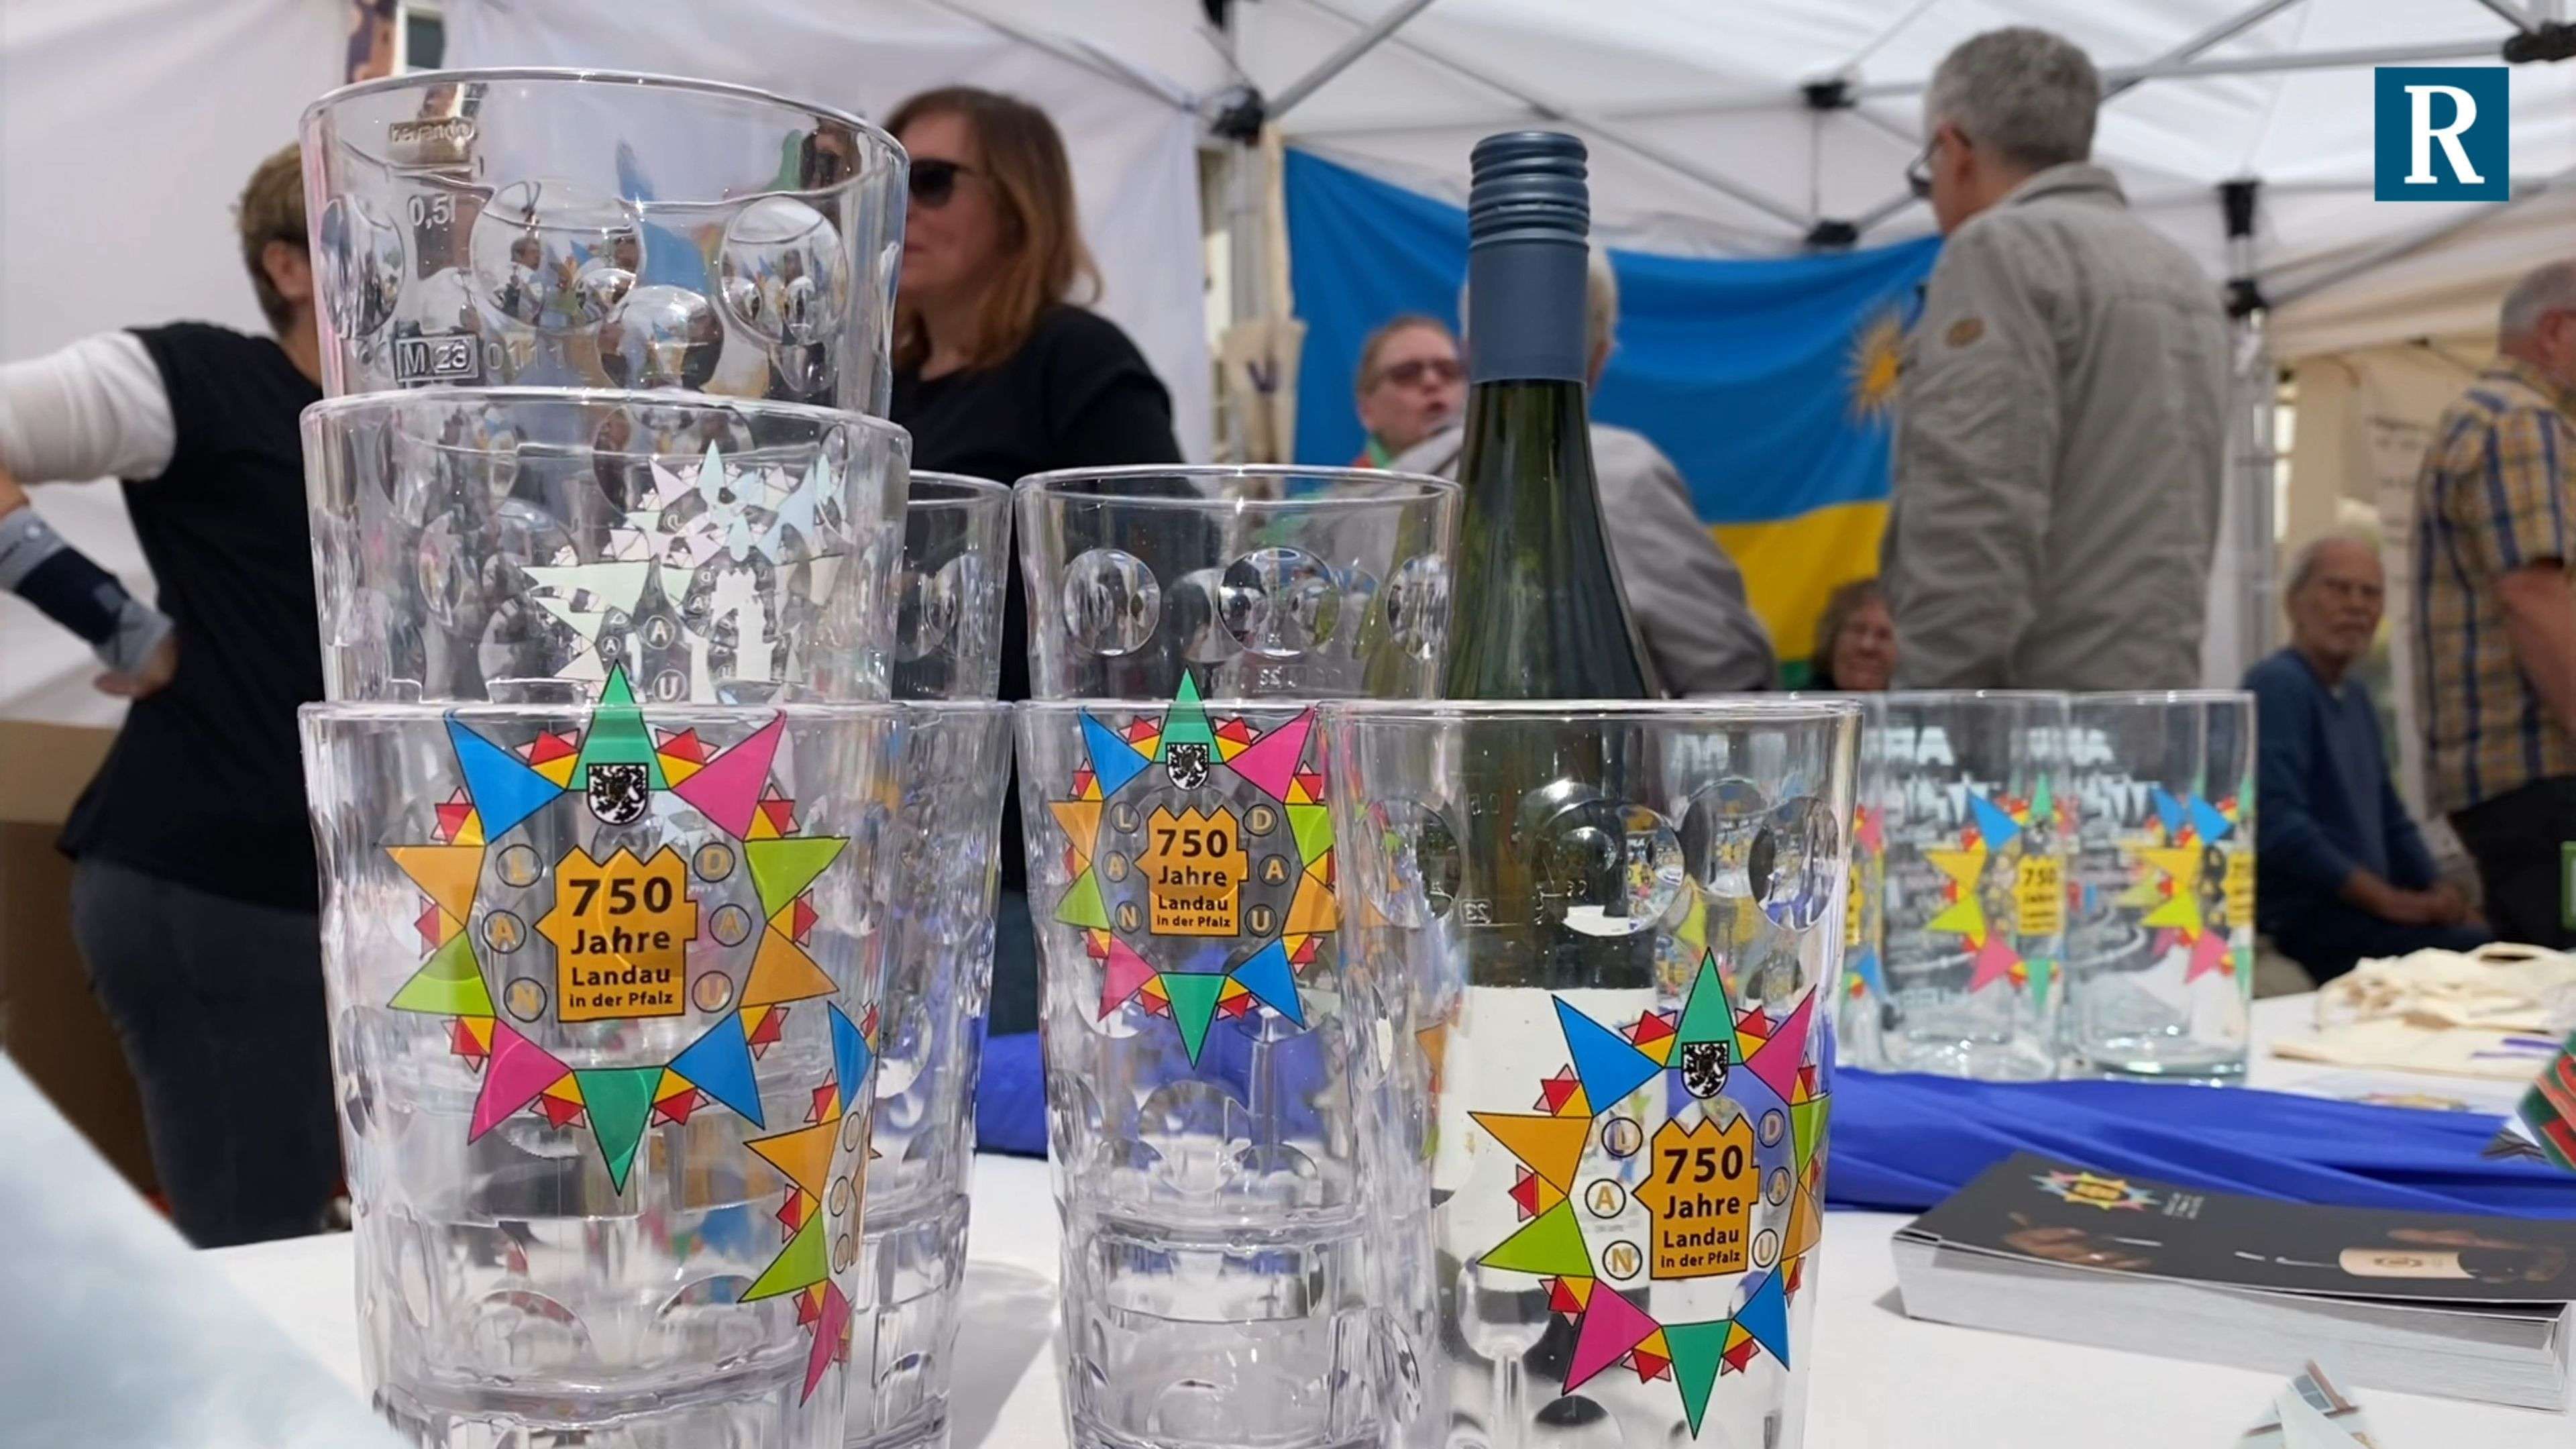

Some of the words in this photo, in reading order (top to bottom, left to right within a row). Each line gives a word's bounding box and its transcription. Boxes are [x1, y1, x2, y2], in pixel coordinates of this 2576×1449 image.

[1119, 809, 1132, 828] L
[1252, 809, 1272, 830] D
[1157, 829, 1229, 858] 750
[511, 855, 531, 879] L
[703, 849, 727, 873] D
[1108, 857, 1124, 875] A
[1265, 859, 1285, 880] A
[1158, 865, 1227, 887] Jahre
[569, 876, 672, 917] 750
[1158, 895, 1228, 911] Landau
[718, 912, 743, 936] A
[1120, 908, 1137, 926] N
[1157, 916, 1169, 926] in
[1172, 916, 1193, 927] der
[1197, 916, 1231, 928] Pfalz
[1252, 910, 1271, 931] U
[492, 916, 517, 943] A
[570, 926, 671, 955] Jahre
[572, 965, 671, 987] Landau
[514, 986, 537, 1010] N
[570, 994, 586, 1007] in
[594, 993, 623, 1006] der
[629, 991, 674, 1006] Pfalz
[701, 980, 724, 1005] U
[1764, 1116, 1779, 1139] D
[1664, 1144, 1743, 1184] 750
[1770, 1175, 1787, 1197] A
[1594, 1185, 1616, 1211] A
[1663, 1194, 1741, 1220] Jahre
[1663, 1228, 1739, 1248] Landau
[1758, 1238, 1773, 1260] U
[1611, 1247, 1633, 1274] N
[1660, 1254, 1676, 1268] in
[1680, 1252, 1704, 1268] der
[1708, 1249, 1741, 1265] Pfalz
